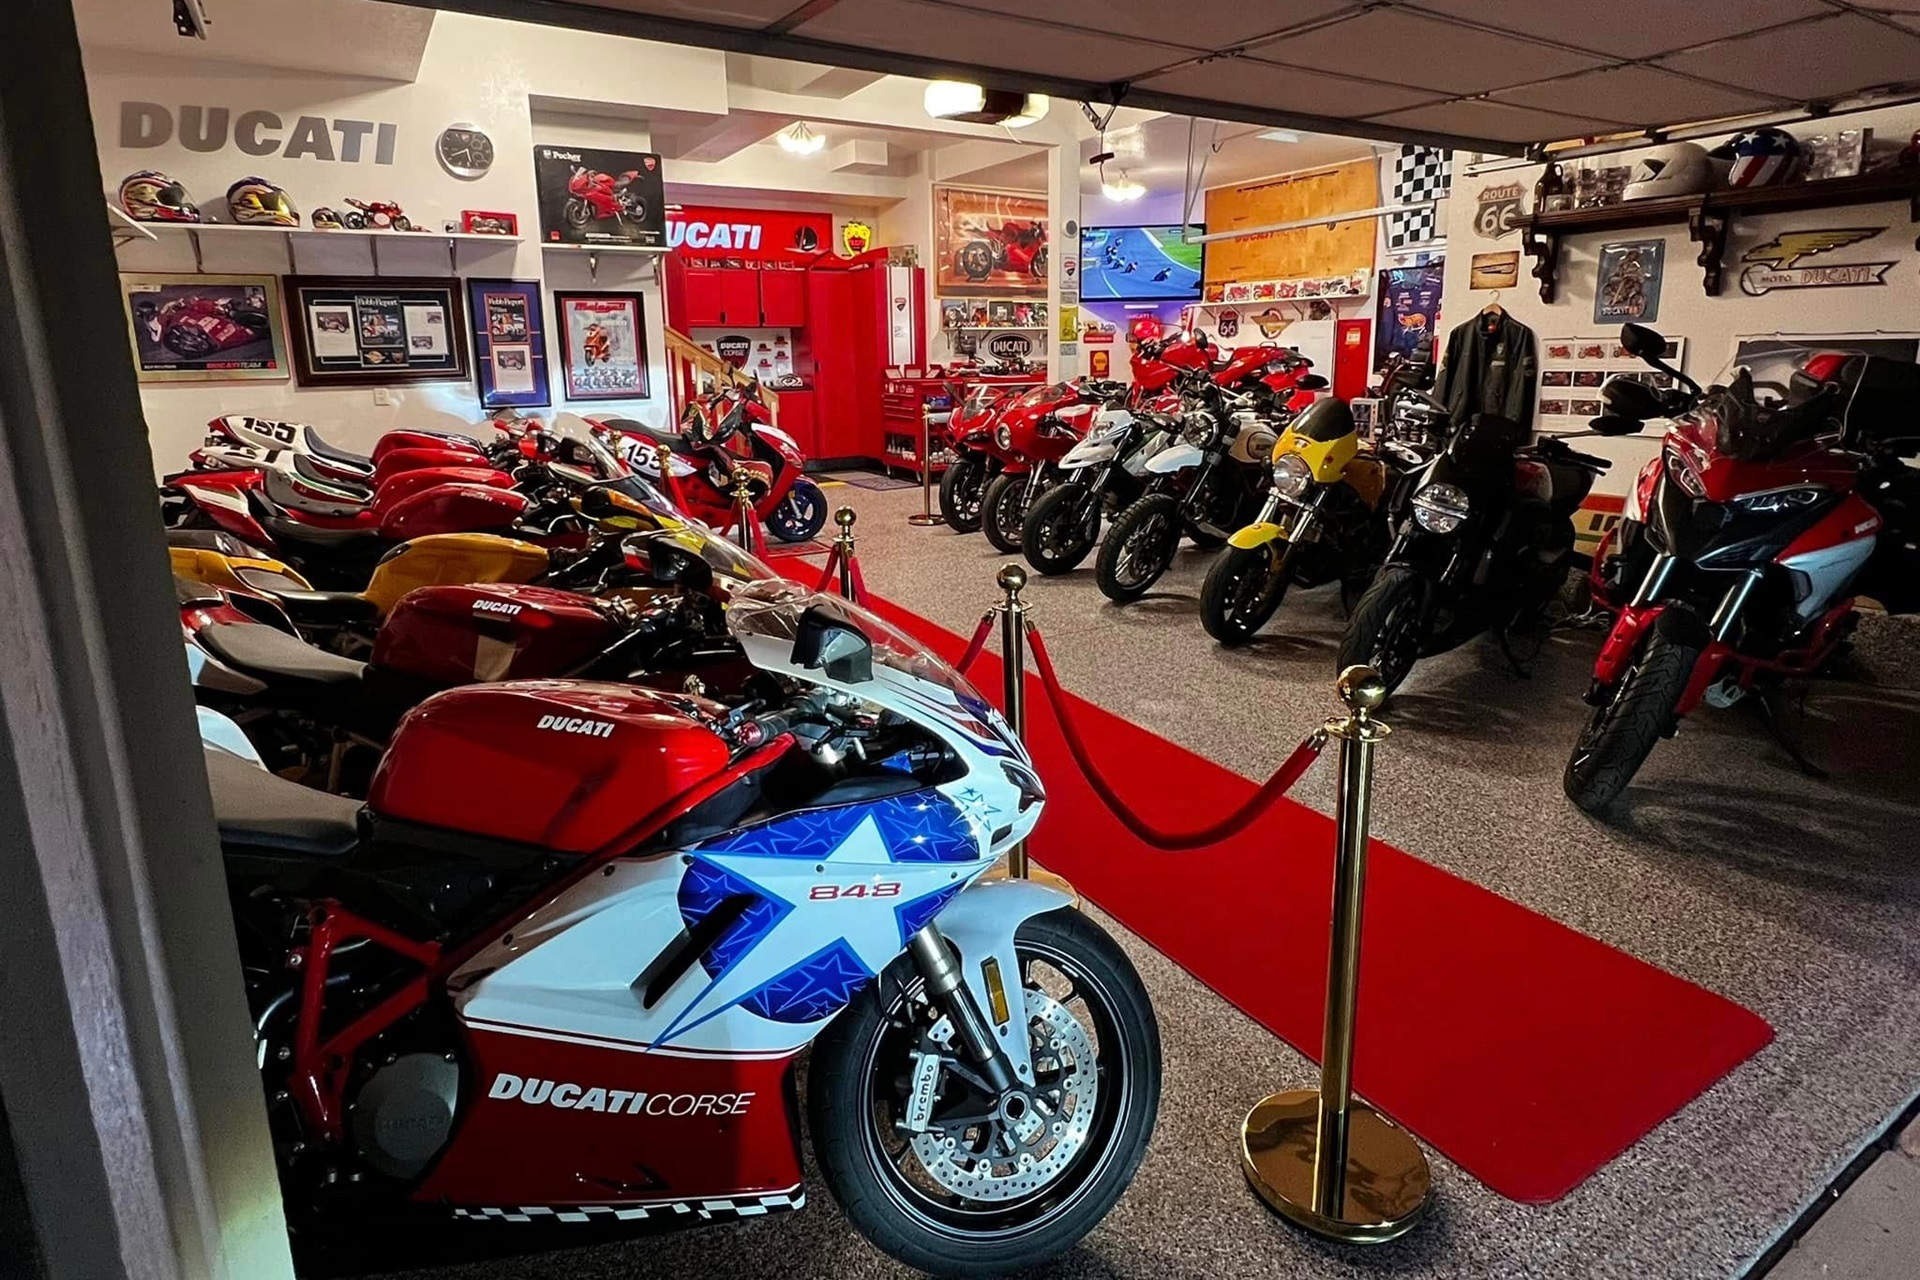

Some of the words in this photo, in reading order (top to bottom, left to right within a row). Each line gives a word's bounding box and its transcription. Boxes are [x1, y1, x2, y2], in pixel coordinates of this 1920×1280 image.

[120, 101, 397, 165] DUCATI
[553, 151, 582, 162] Pocher
[1483, 187, 1519, 200] ROUTE
[1481, 204, 1517, 232] 66
[665, 221, 762, 249] UCATI
[1760, 274, 1792, 283] MOTO
[1801, 267, 1871, 284] DUCATI
[1220, 321, 1236, 337] 66
[720, 342, 749, 350] DUCATI
[993, 340, 1028, 352] DUCATI
[242, 418, 297, 444] 155
[472, 600, 523, 615] DUCATI
[536, 715, 615, 738] DUCATI
[809, 882, 901, 900] 848
[914, 1064, 934, 1122] brembo
